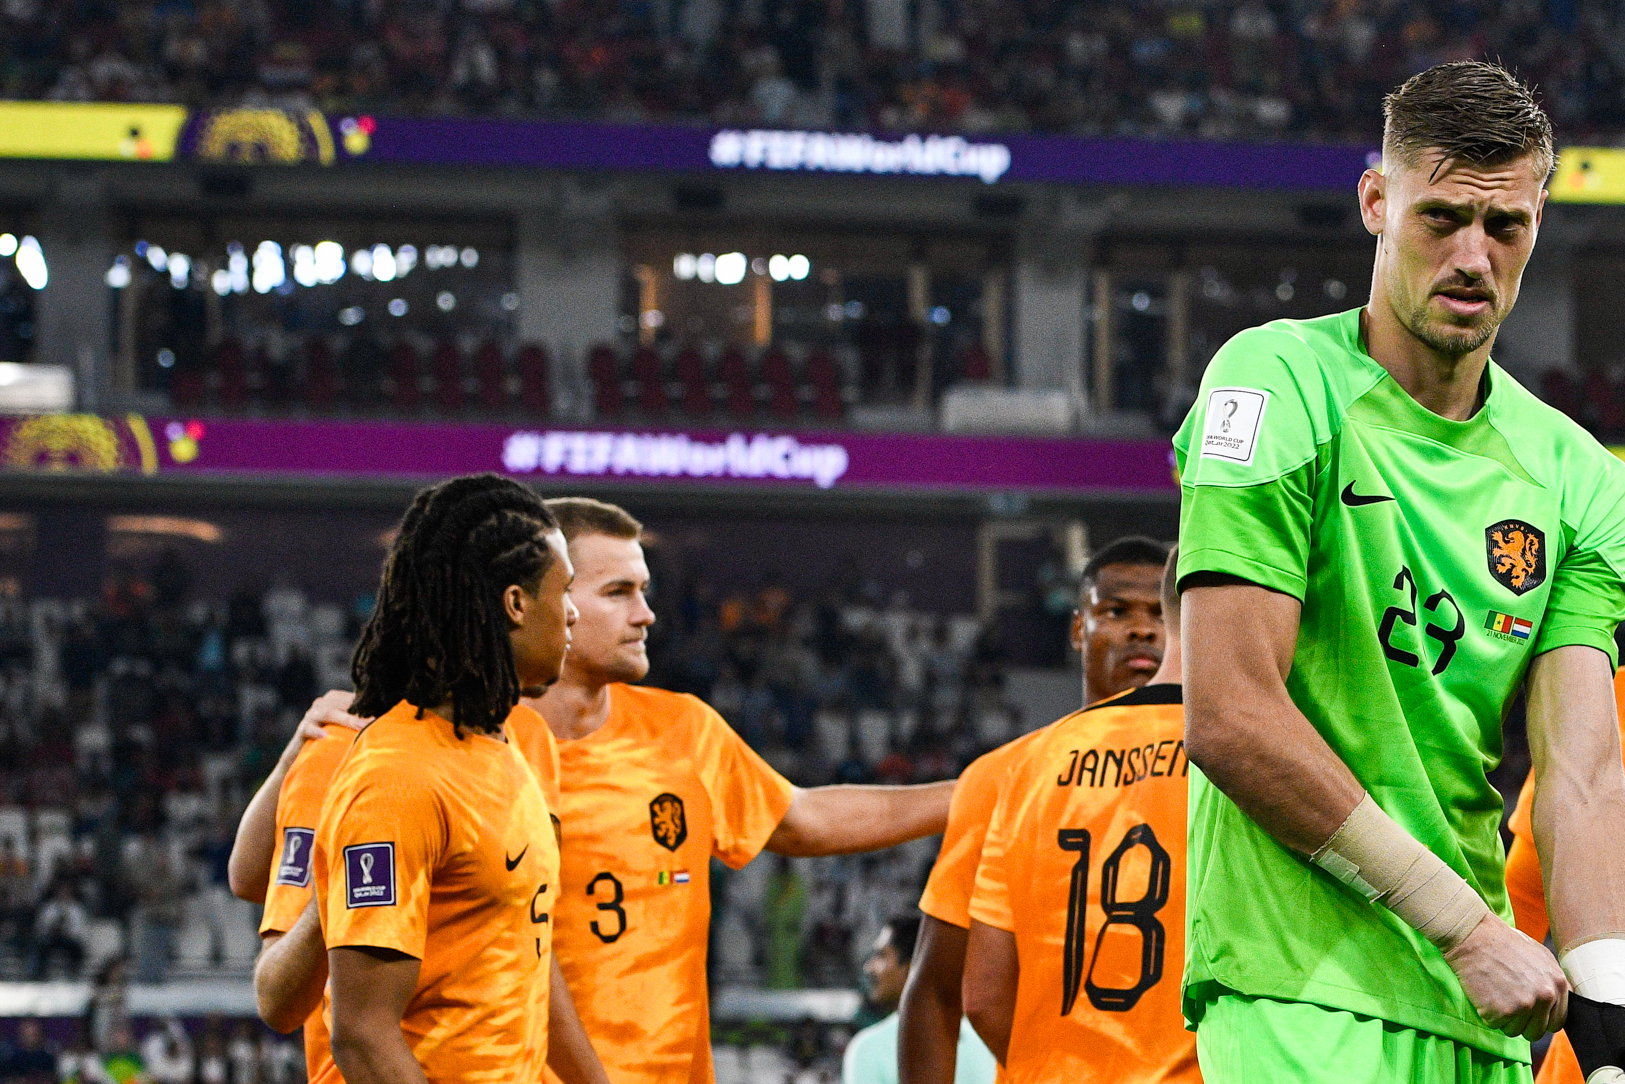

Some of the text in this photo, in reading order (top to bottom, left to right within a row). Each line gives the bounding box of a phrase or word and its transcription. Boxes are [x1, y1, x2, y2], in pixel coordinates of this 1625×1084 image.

[710, 129, 1011, 183] #FIFAWorldCup
[503, 431, 849, 488] #FIFAWorldCup
[1378, 565, 1465, 676] 23
[586, 871, 627, 943] 3
[1058, 823, 1171, 1017] 18
